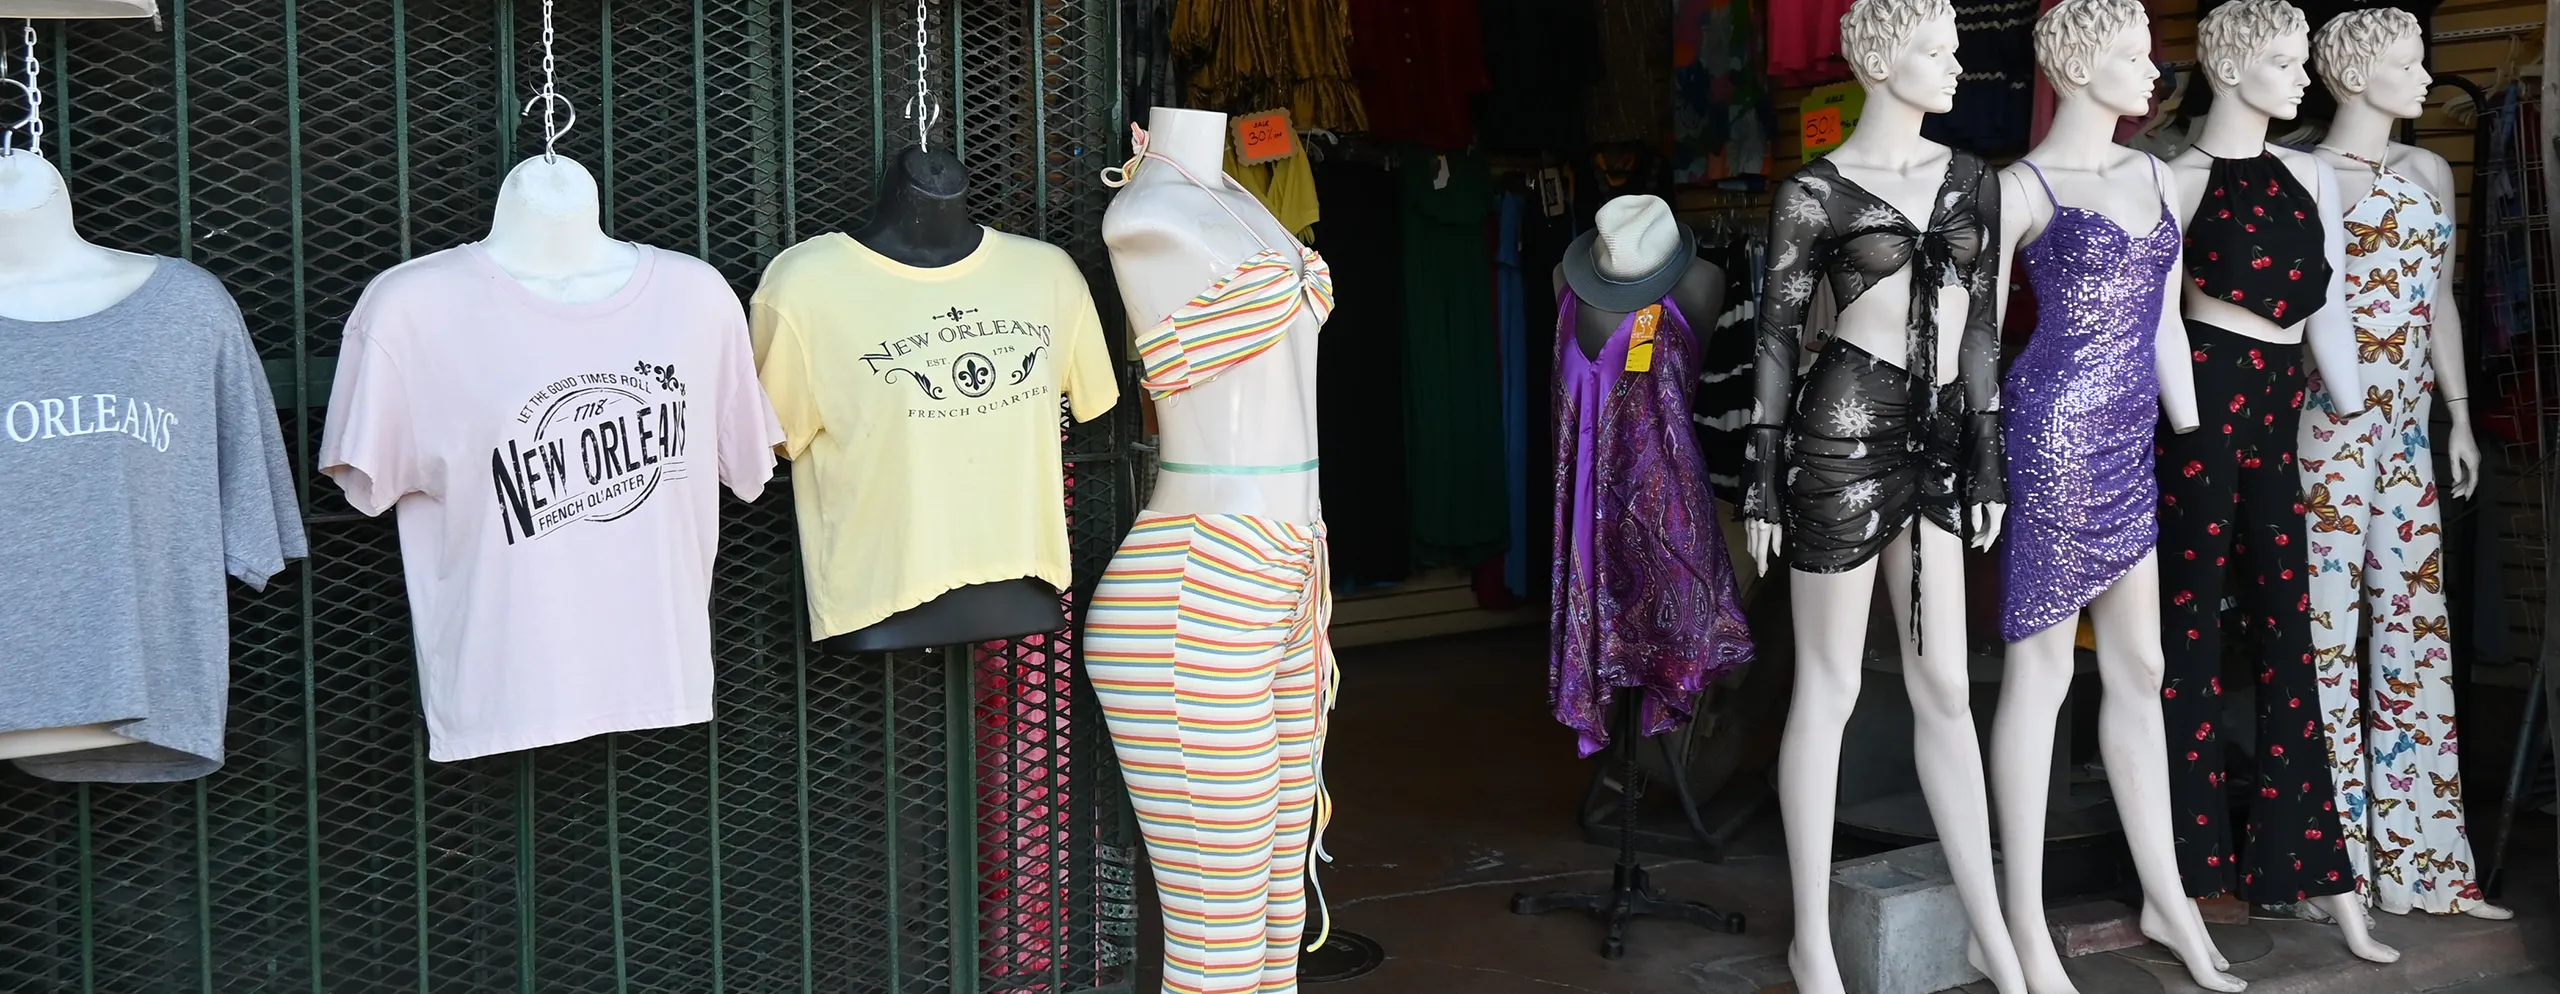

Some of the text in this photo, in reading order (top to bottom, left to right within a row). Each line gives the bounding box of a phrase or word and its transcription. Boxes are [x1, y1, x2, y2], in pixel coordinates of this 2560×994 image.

[858, 320, 1050, 375] NEW ORLEANS
[926, 345, 1015, 367] EST. 1718
[517, 373, 651, 424] LET THE GOOD TIMES ROLL
[574, 398, 608, 422] 1718
[908, 385, 1049, 418] FRENCH QUARTER
[492, 400, 686, 545] NEW ORLEANS
[539, 474, 645, 531] FRENCH QUARTER
